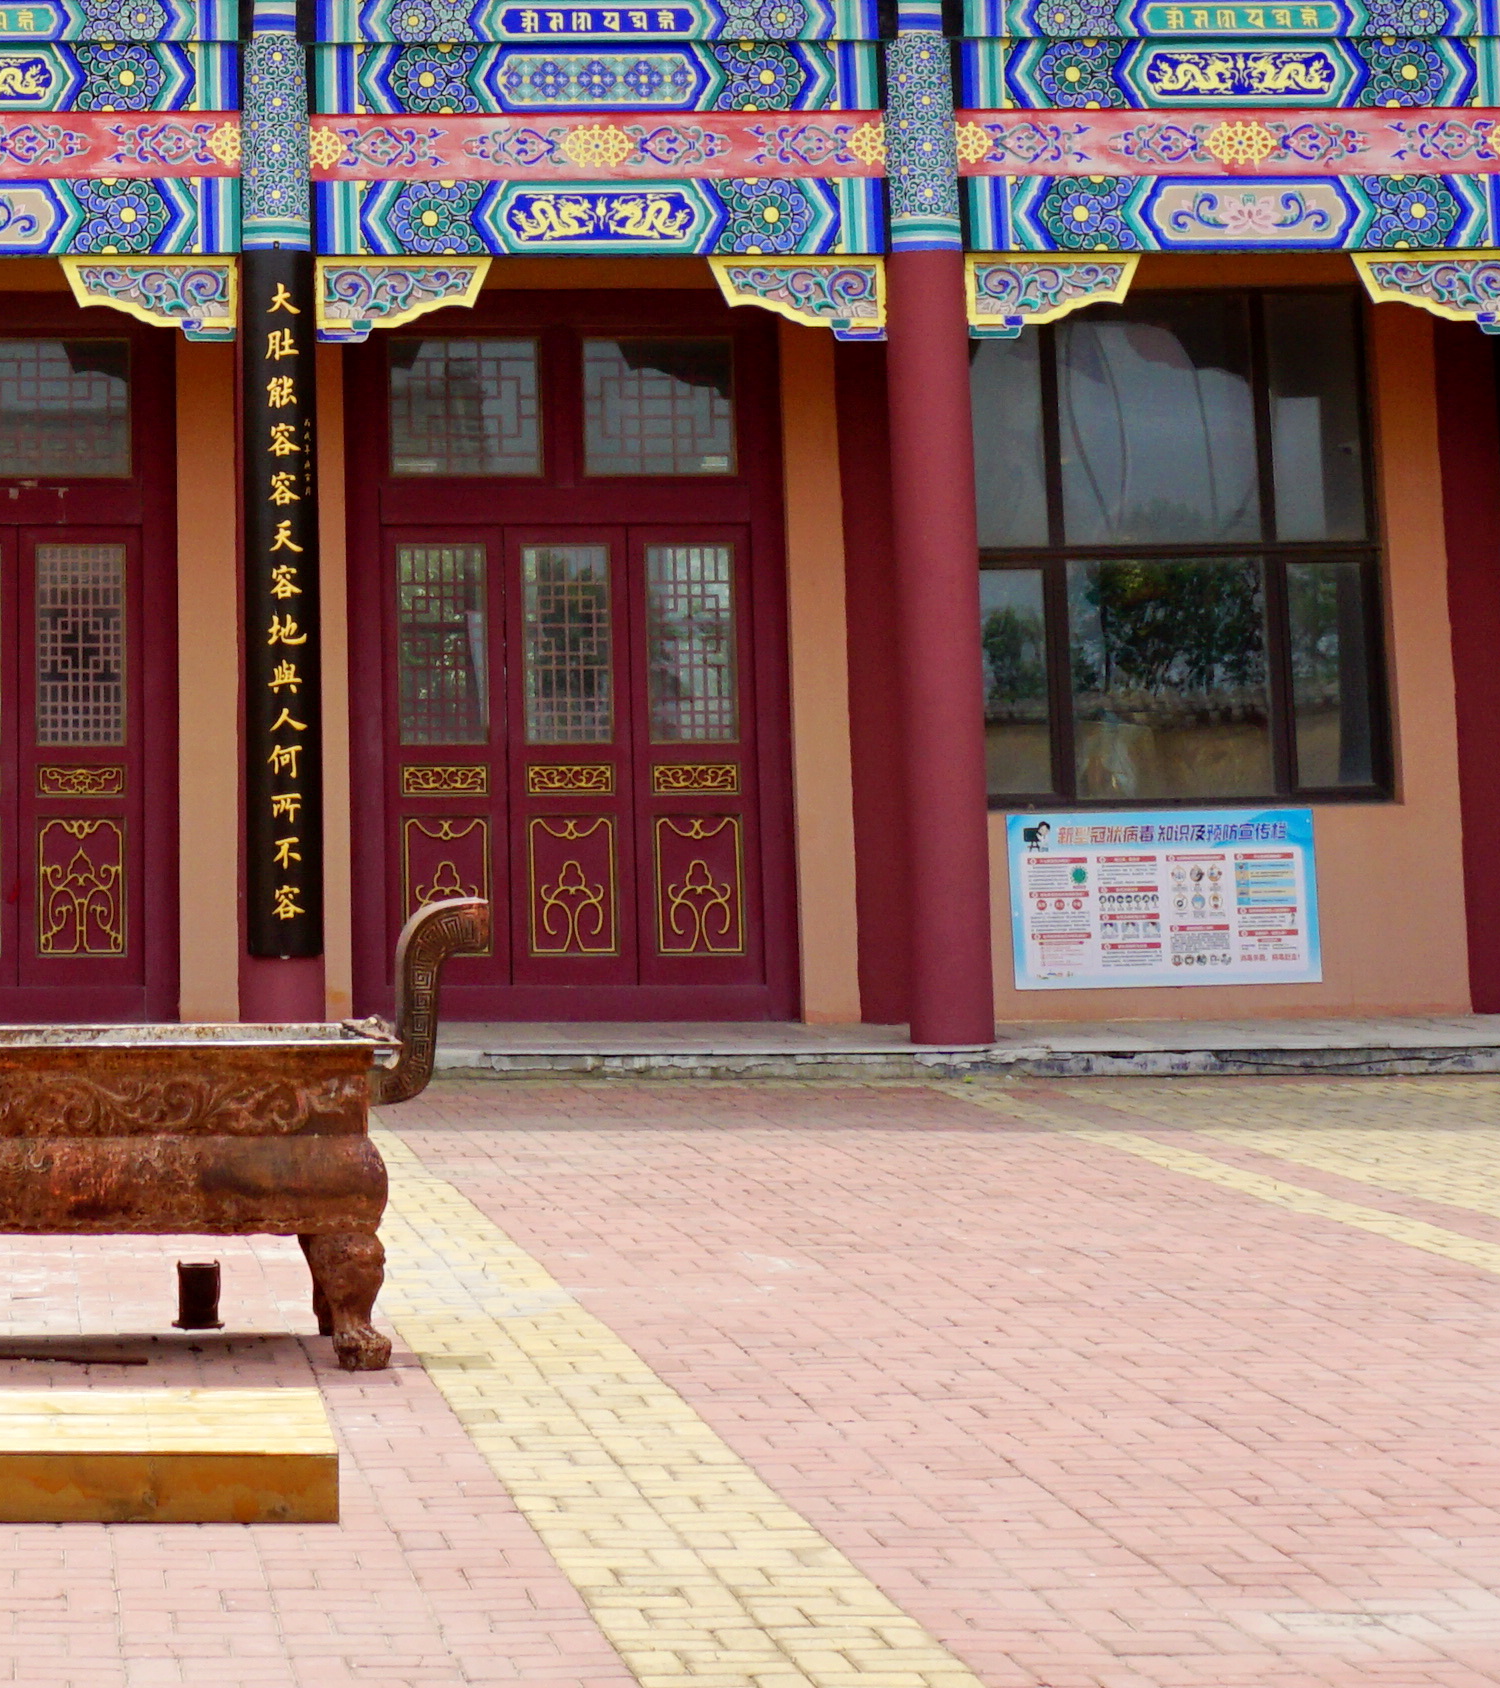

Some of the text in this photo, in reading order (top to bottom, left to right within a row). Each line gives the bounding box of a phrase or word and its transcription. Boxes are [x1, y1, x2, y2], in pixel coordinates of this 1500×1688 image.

[265, 282, 308, 922] 大肚能容容天容地與人何所不容
